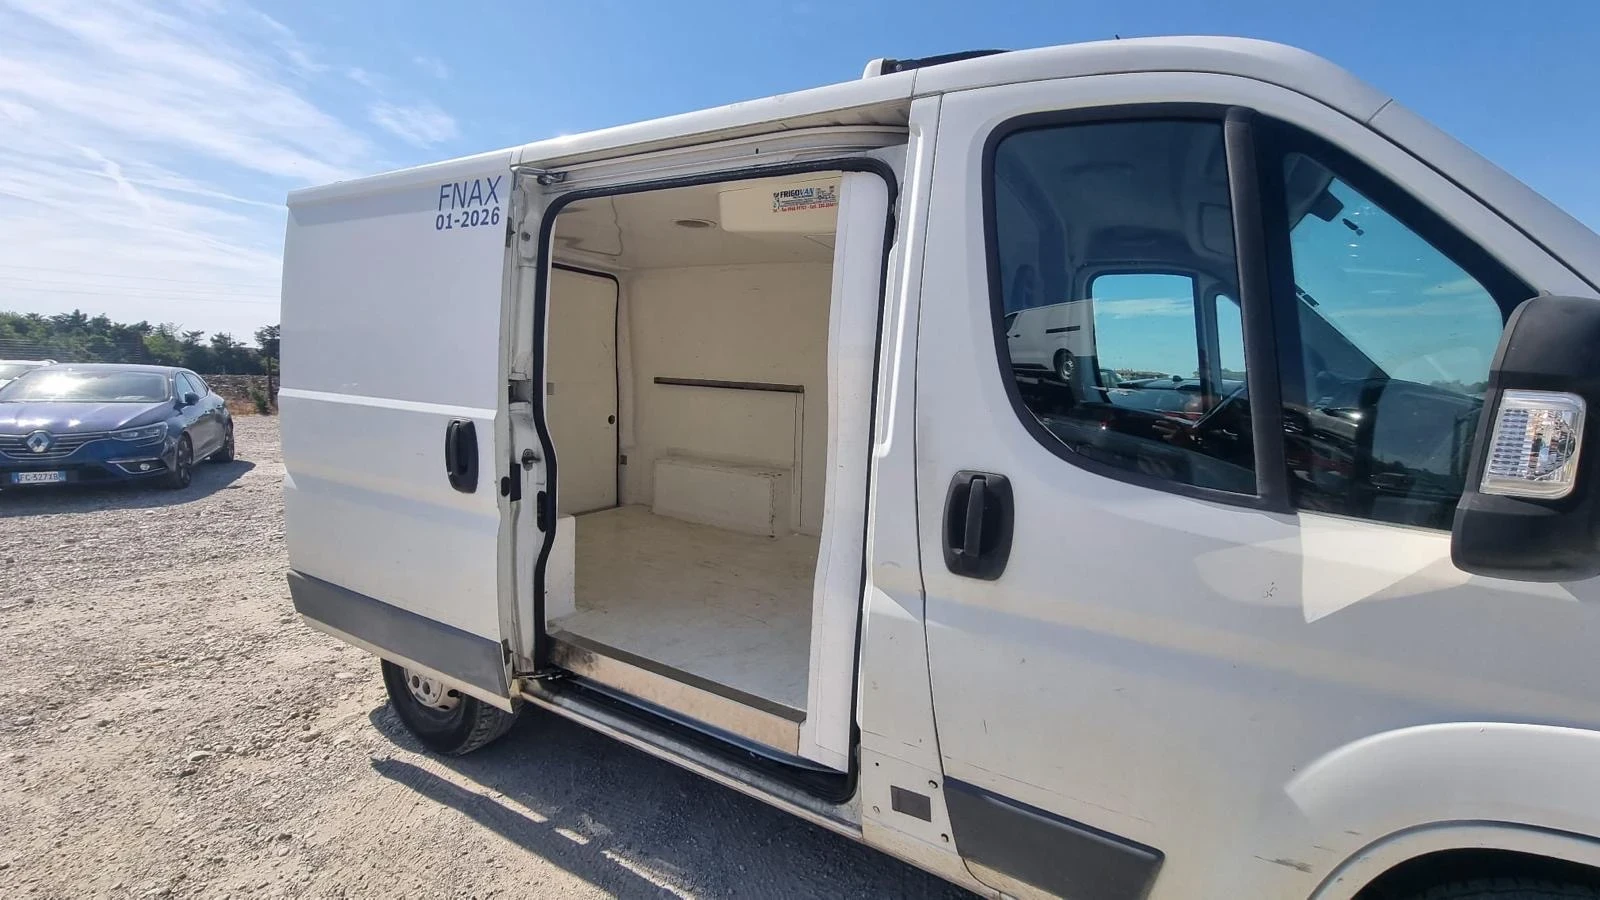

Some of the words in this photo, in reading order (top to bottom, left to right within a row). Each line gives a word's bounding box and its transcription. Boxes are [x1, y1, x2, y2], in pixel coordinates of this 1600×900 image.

[438, 175, 502, 211] FNAX
[780, 187, 814, 198] FRIGOVAN
[436, 206, 500, 230] 01-2026
